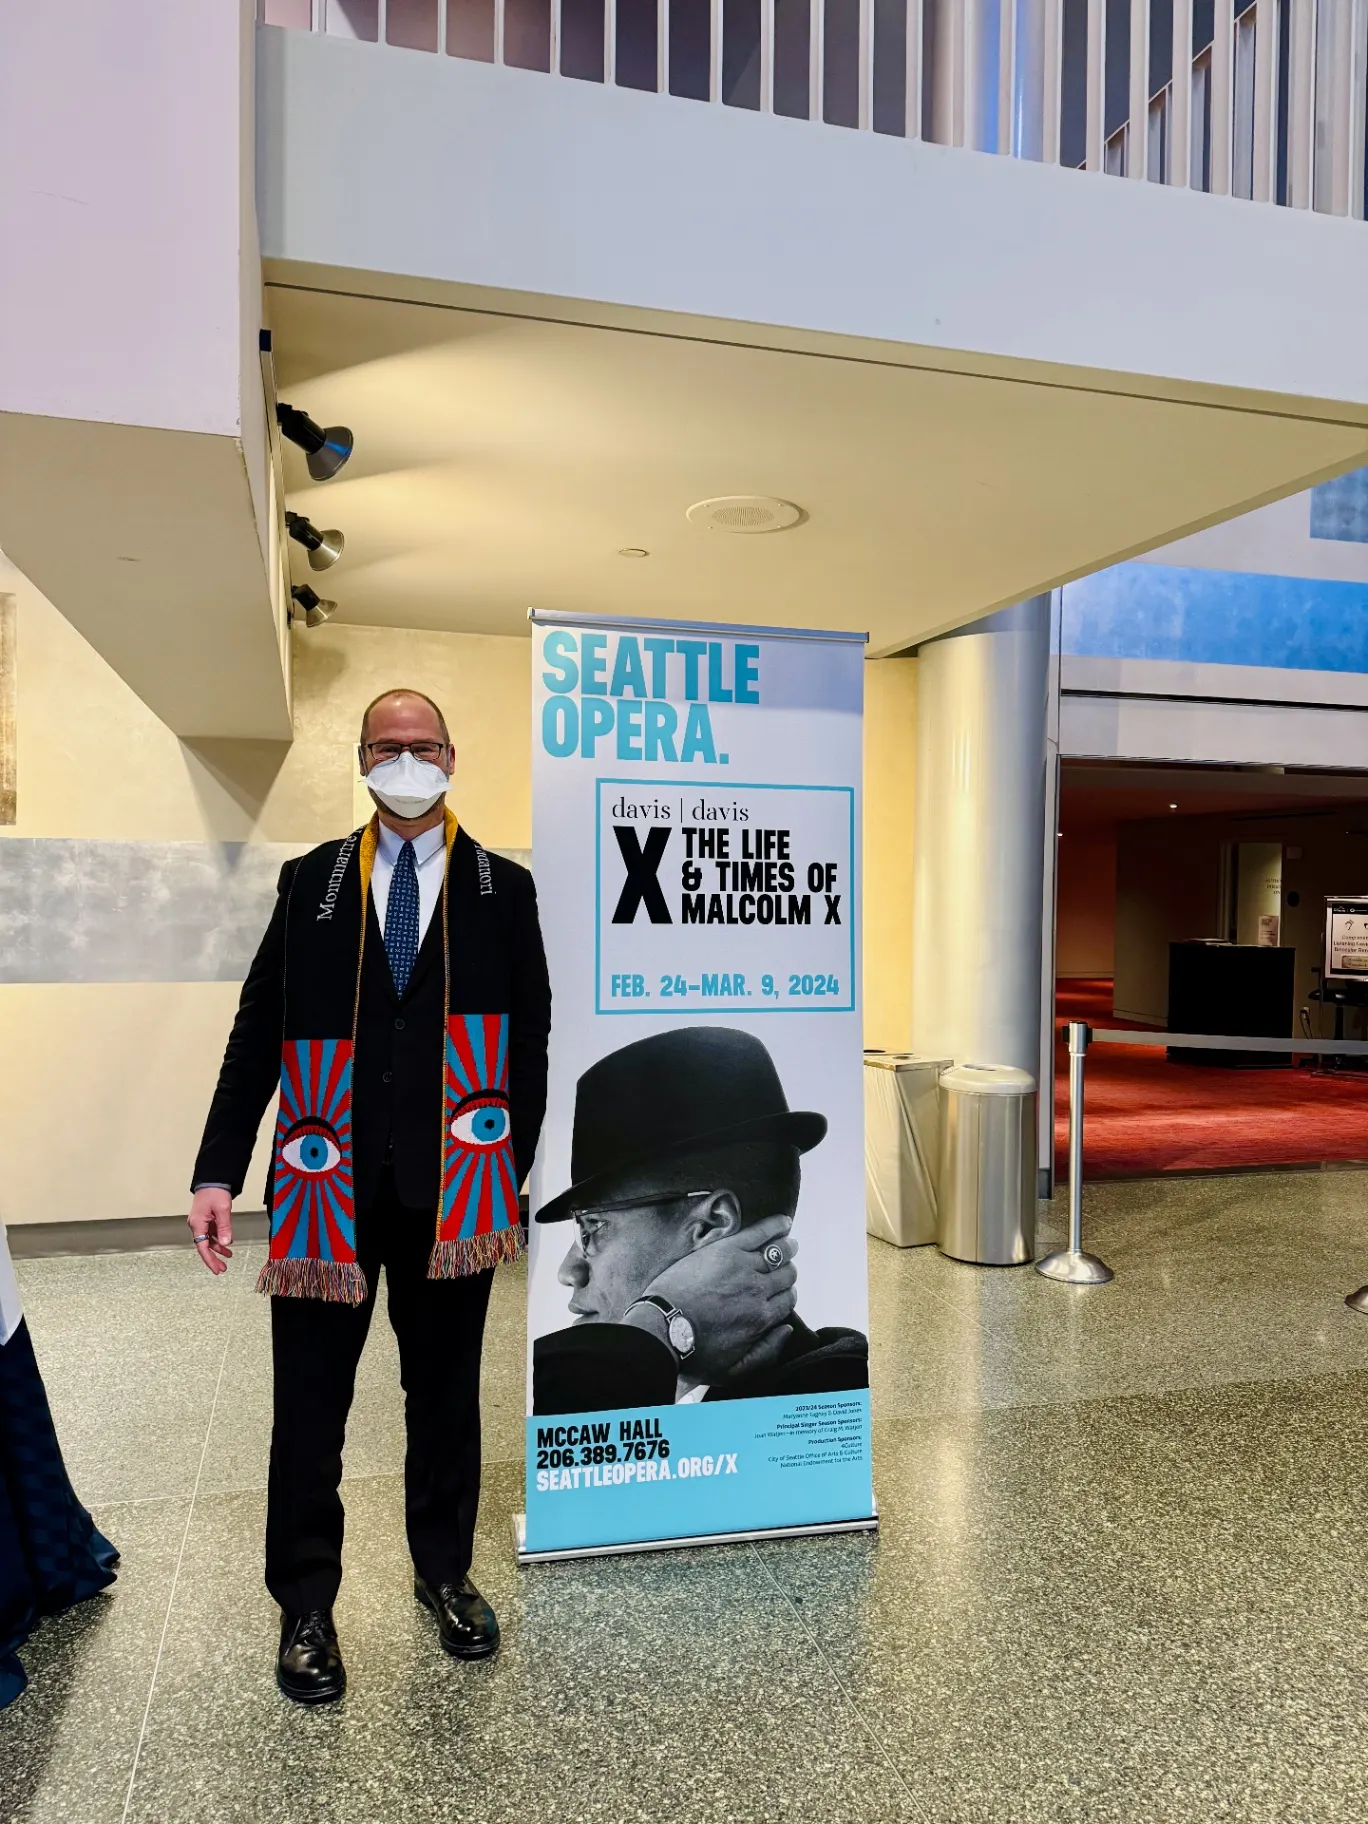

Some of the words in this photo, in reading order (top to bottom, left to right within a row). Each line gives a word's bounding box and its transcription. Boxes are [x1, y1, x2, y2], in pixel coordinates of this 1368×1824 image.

[542, 630, 760, 704] SEATTLE
[542, 695, 730, 765] OPERA.
[612, 797, 671, 819] davis
[692, 799, 749, 822] davis
[682, 828, 729, 860] THE
[742, 829, 790, 861] LIFE
[612, 825, 673, 924] X
[681, 861, 703, 892] &
[715, 862, 795, 893] TIMES
[807, 863, 838, 893] OF
[682, 894, 811, 925] MALCOLM
[824, 894, 841, 925] X
[611, 974, 650, 998] FEB.
[762, 974, 780, 1000] 9,
[788, 974, 840, 996] 2024
[537, 1423, 611, 1448] MCCAW
[620, 1418, 663, 1442] HALL
[776, 1422, 800, 1430] Principal
[796, 1428, 816, 1436] memory
[537, 1439, 670, 1470] 206.389.7676
[536, 1453, 738, 1492] SEATTLEOPERA.ORG/X
